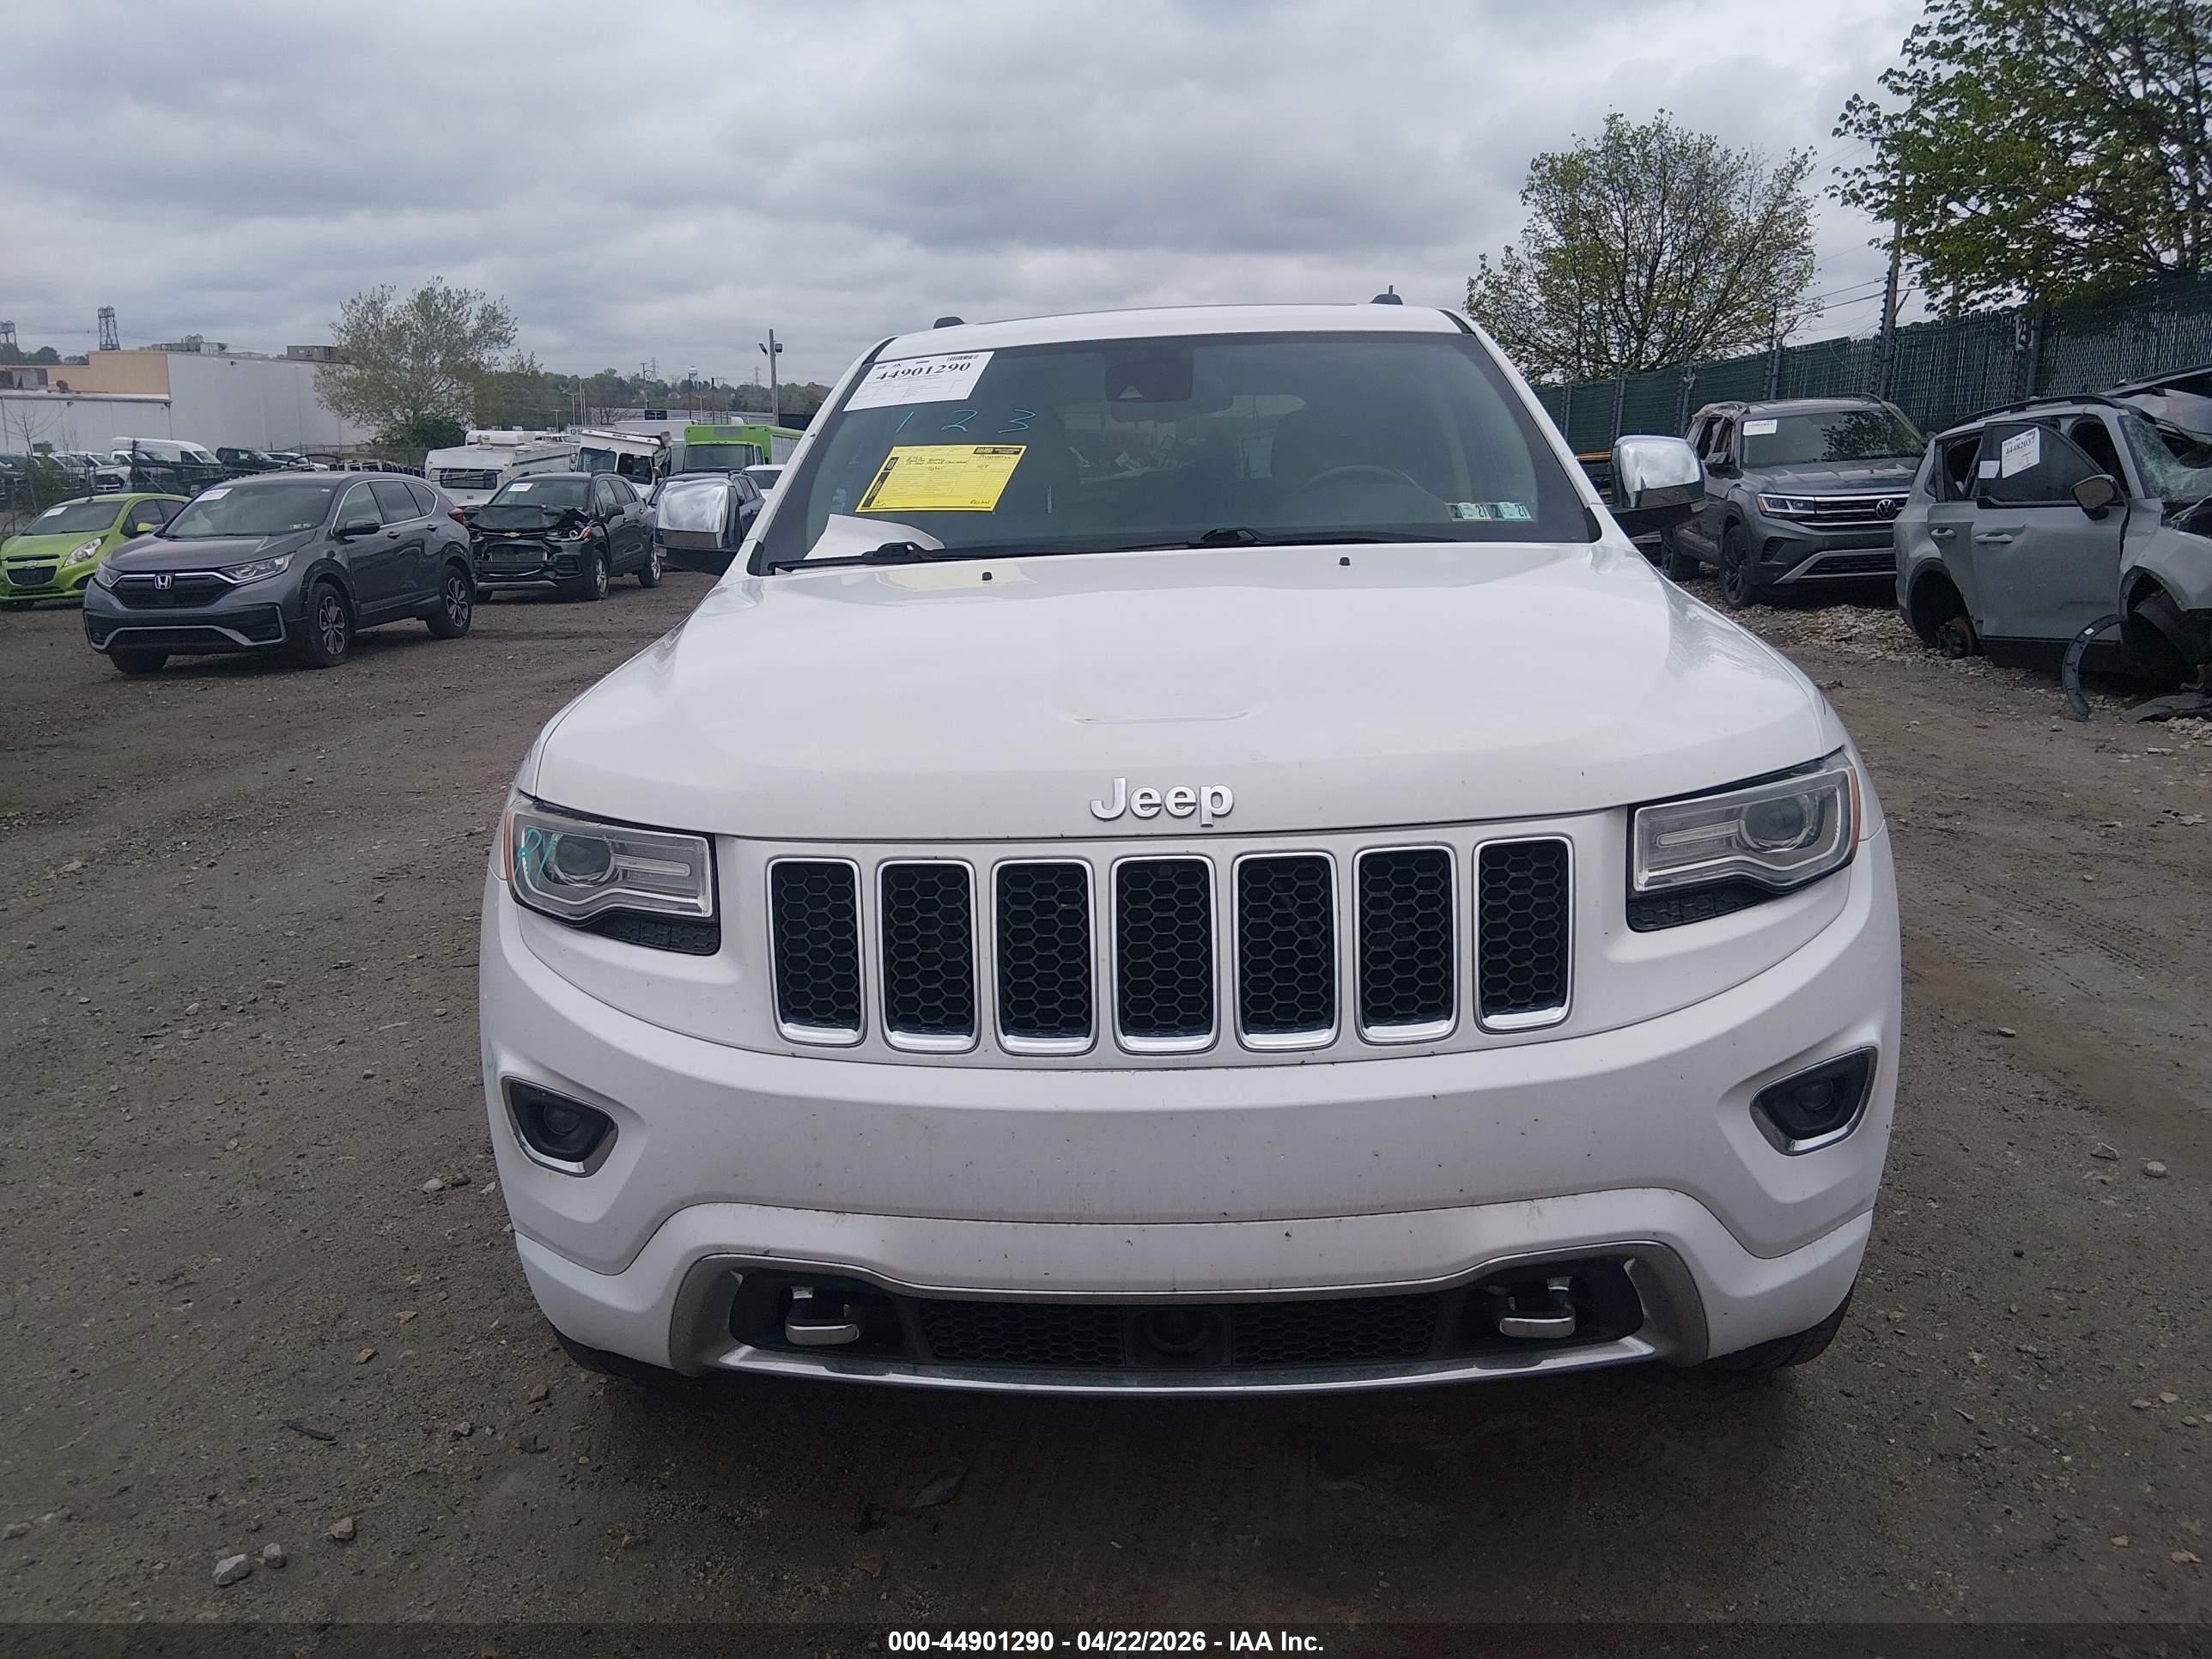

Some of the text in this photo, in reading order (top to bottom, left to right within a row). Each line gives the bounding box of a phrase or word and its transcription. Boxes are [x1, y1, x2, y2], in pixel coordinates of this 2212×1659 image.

[875, 362, 971, 380] 44901290
[896, 409, 1036, 434] 1 2 3
[1090, 776, 1234, 828] Jeep
